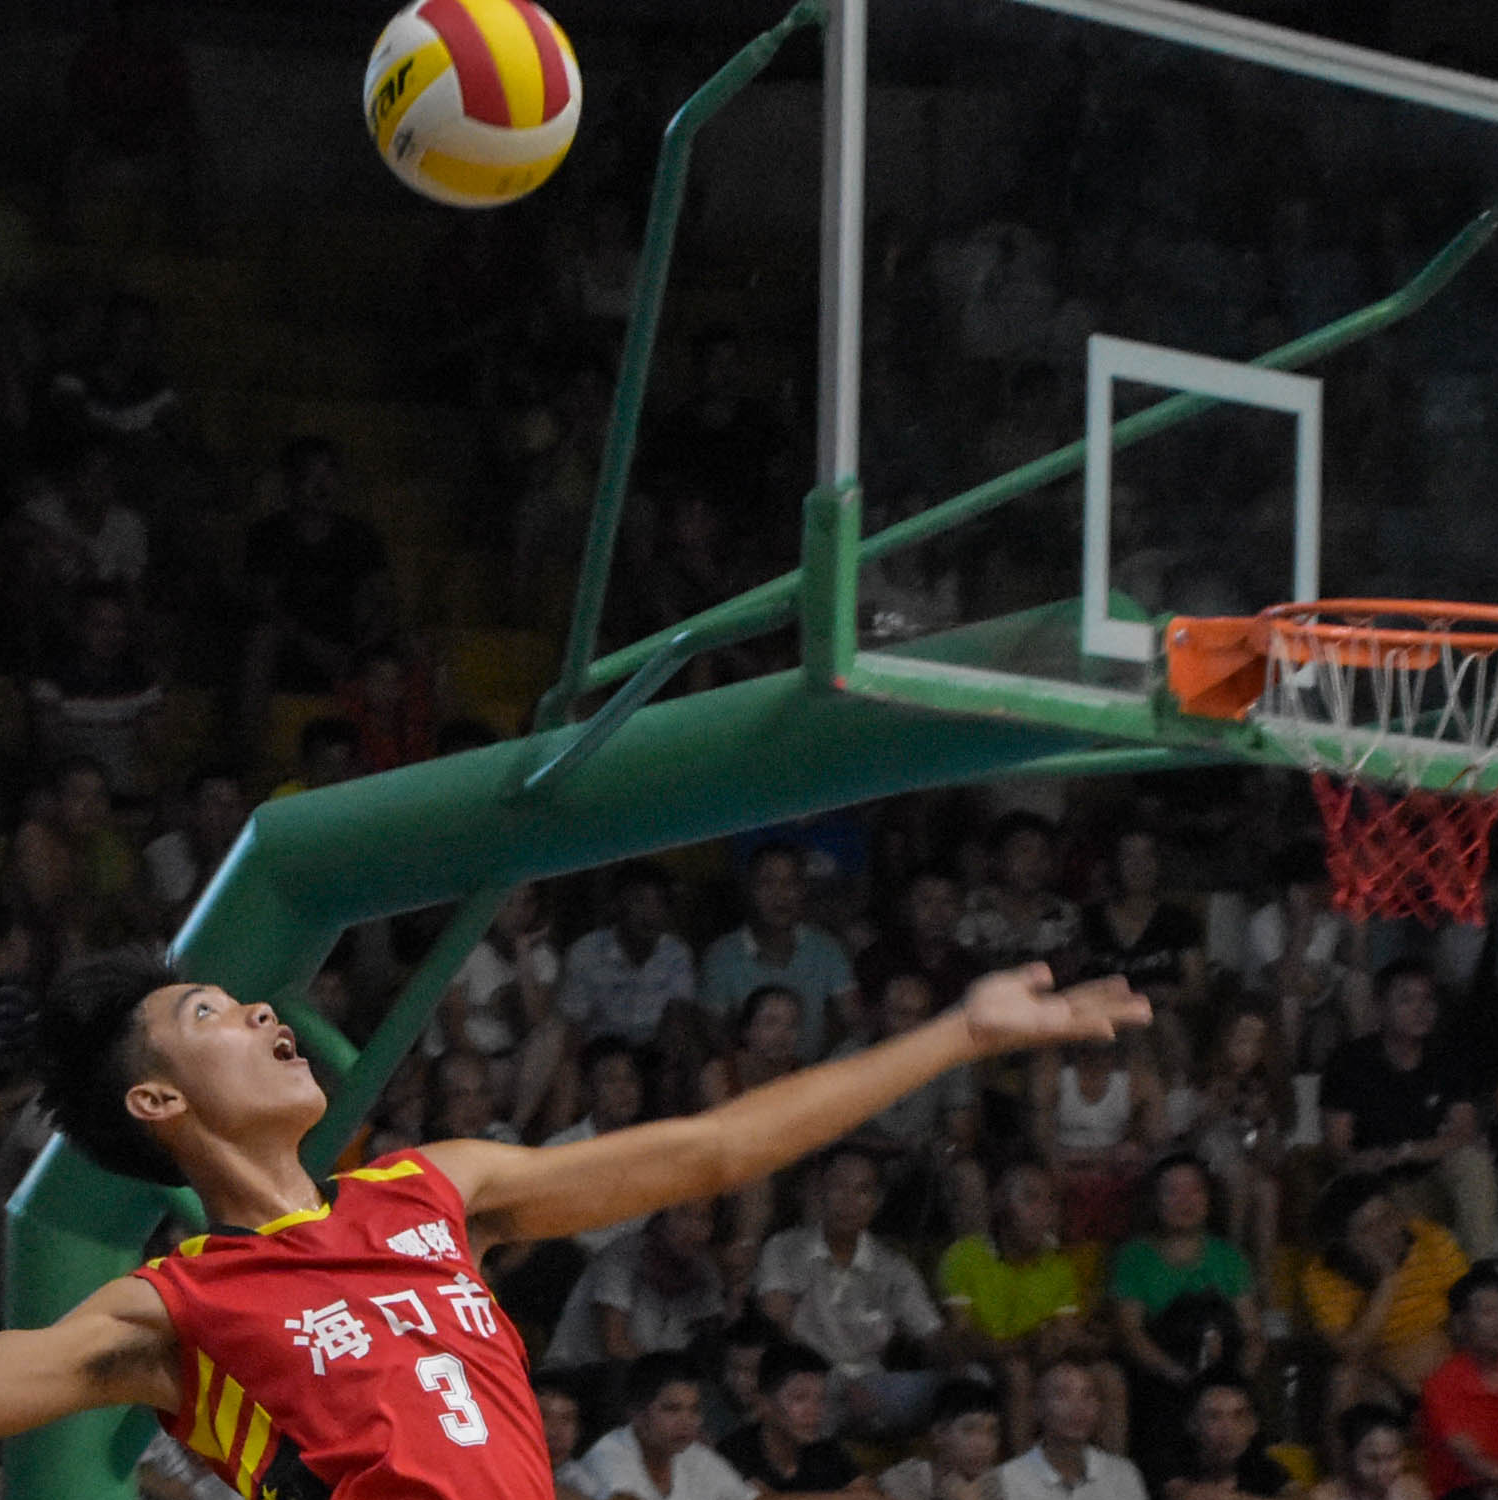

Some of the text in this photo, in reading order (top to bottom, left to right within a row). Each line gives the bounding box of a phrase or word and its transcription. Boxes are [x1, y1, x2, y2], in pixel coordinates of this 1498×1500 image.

[284, 1272, 498, 1376] 海口市
[414, 1353, 489, 1447] 3
